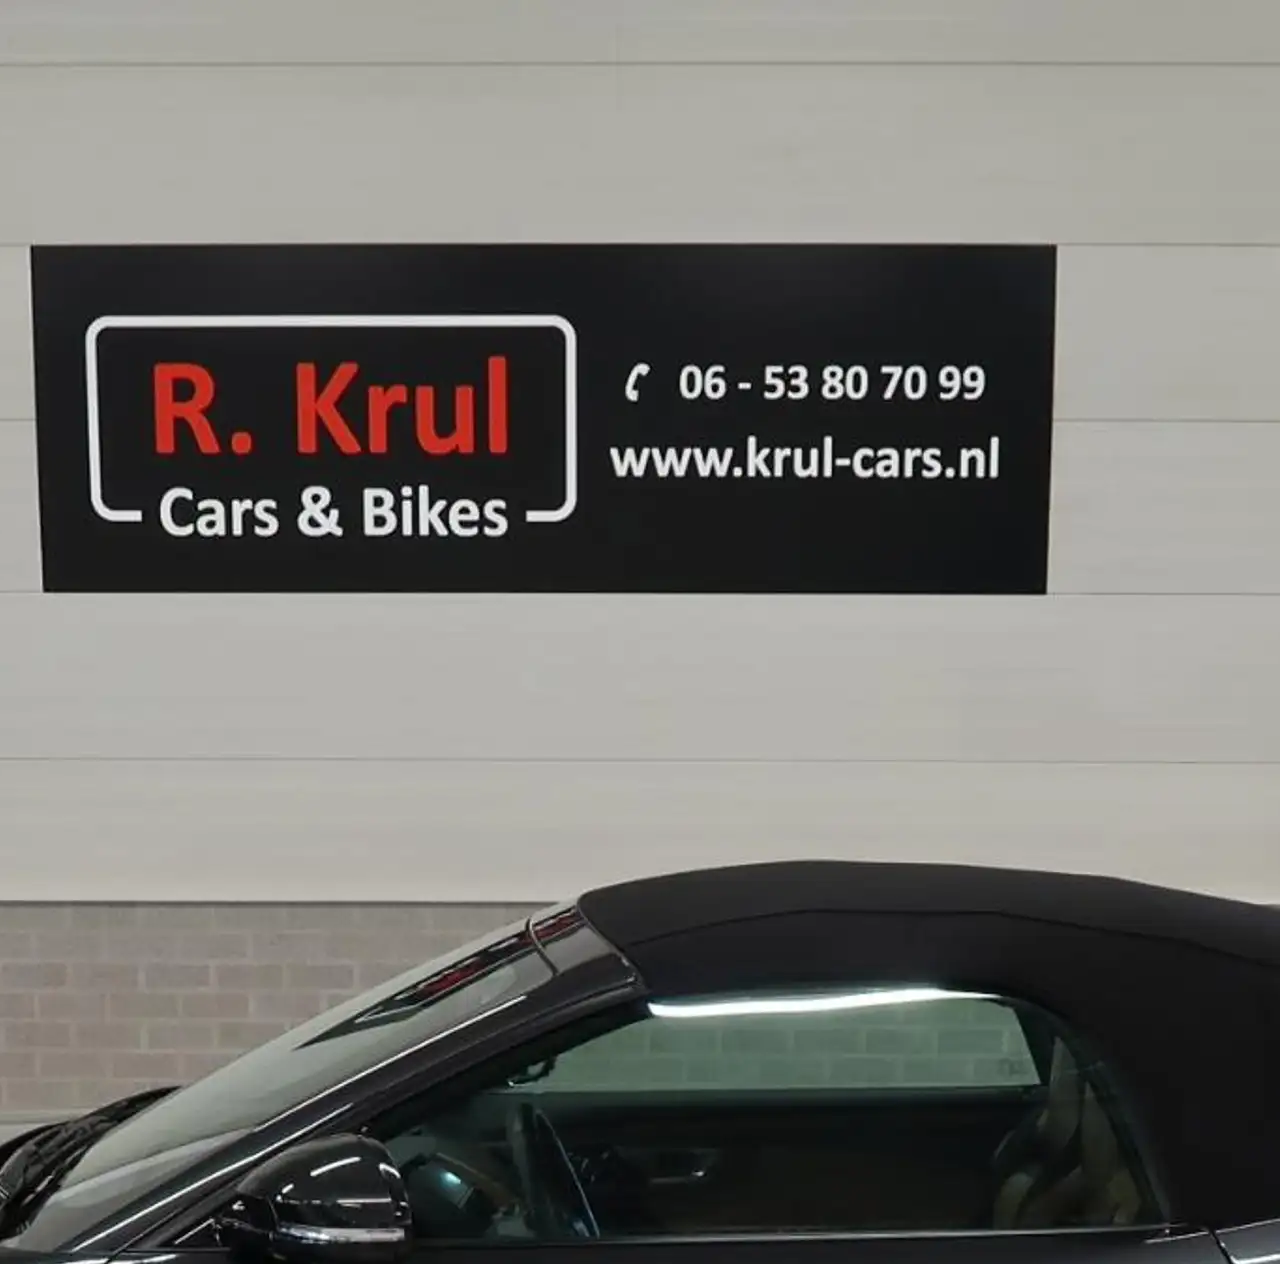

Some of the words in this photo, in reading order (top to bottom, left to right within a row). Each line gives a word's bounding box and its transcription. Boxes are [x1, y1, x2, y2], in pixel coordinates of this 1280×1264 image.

[153, 361, 253, 456] R.
[295, 355, 508, 455] Krul
[679, 365, 727, 400] 06
[737, 382, 752, 390] -
[763, 365, 809, 400] 53
[821, 365, 869, 400] 80
[880, 365, 927, 400] 70
[938, 365, 985, 400] 99
[609, 435, 1000, 479] www.krul-cars.nl
[159, 486, 279, 537] Cars
[297, 485, 344, 537] &
[363, 484, 508, 537] Bikes
